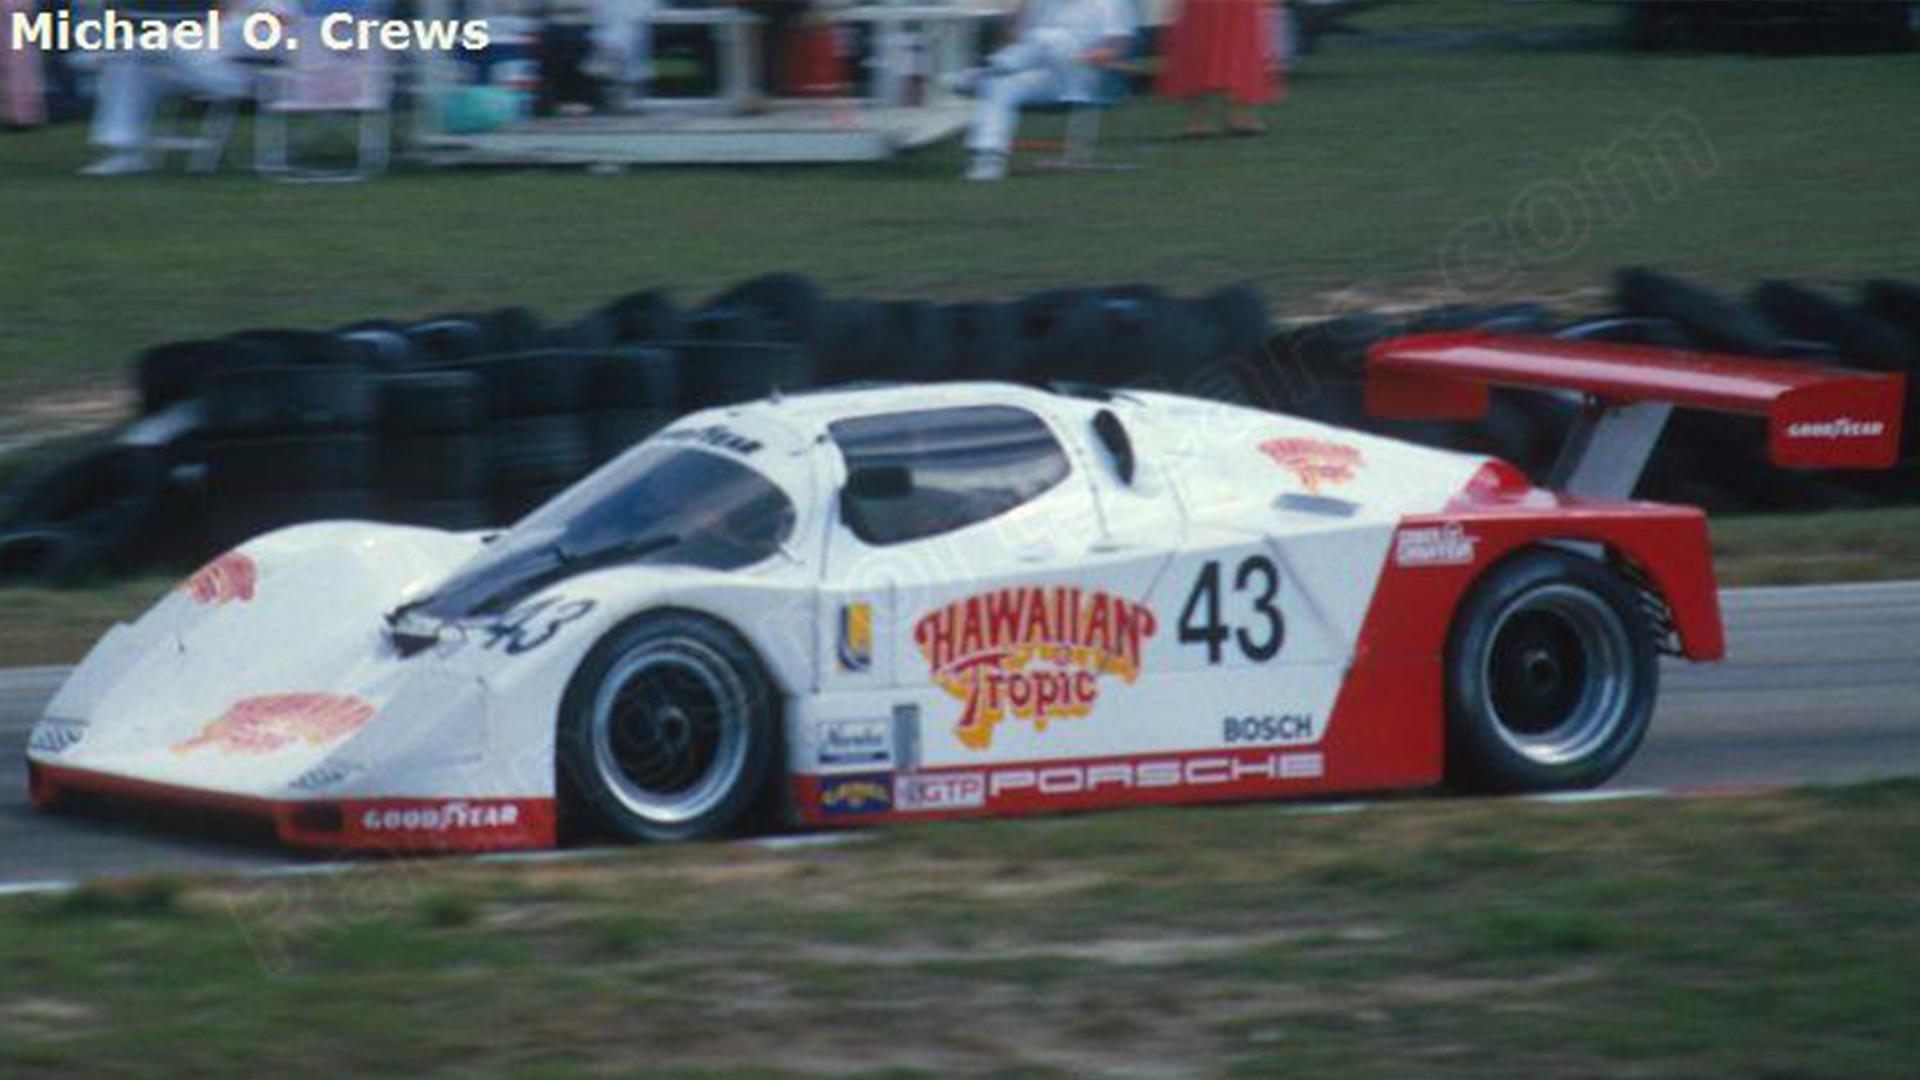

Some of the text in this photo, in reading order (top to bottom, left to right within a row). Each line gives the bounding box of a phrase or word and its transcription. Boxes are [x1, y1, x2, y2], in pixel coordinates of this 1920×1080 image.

[483, 595, 597, 656] 43
[914, 587, 1158, 674] HAWAIIAN
[1177, 555, 1286, 665] 43
[1224, 714, 1312, 743] BOSCH
[989, 751, 1325, 797] PORSCHE
[362, 801, 518, 832] GOODYEAR
